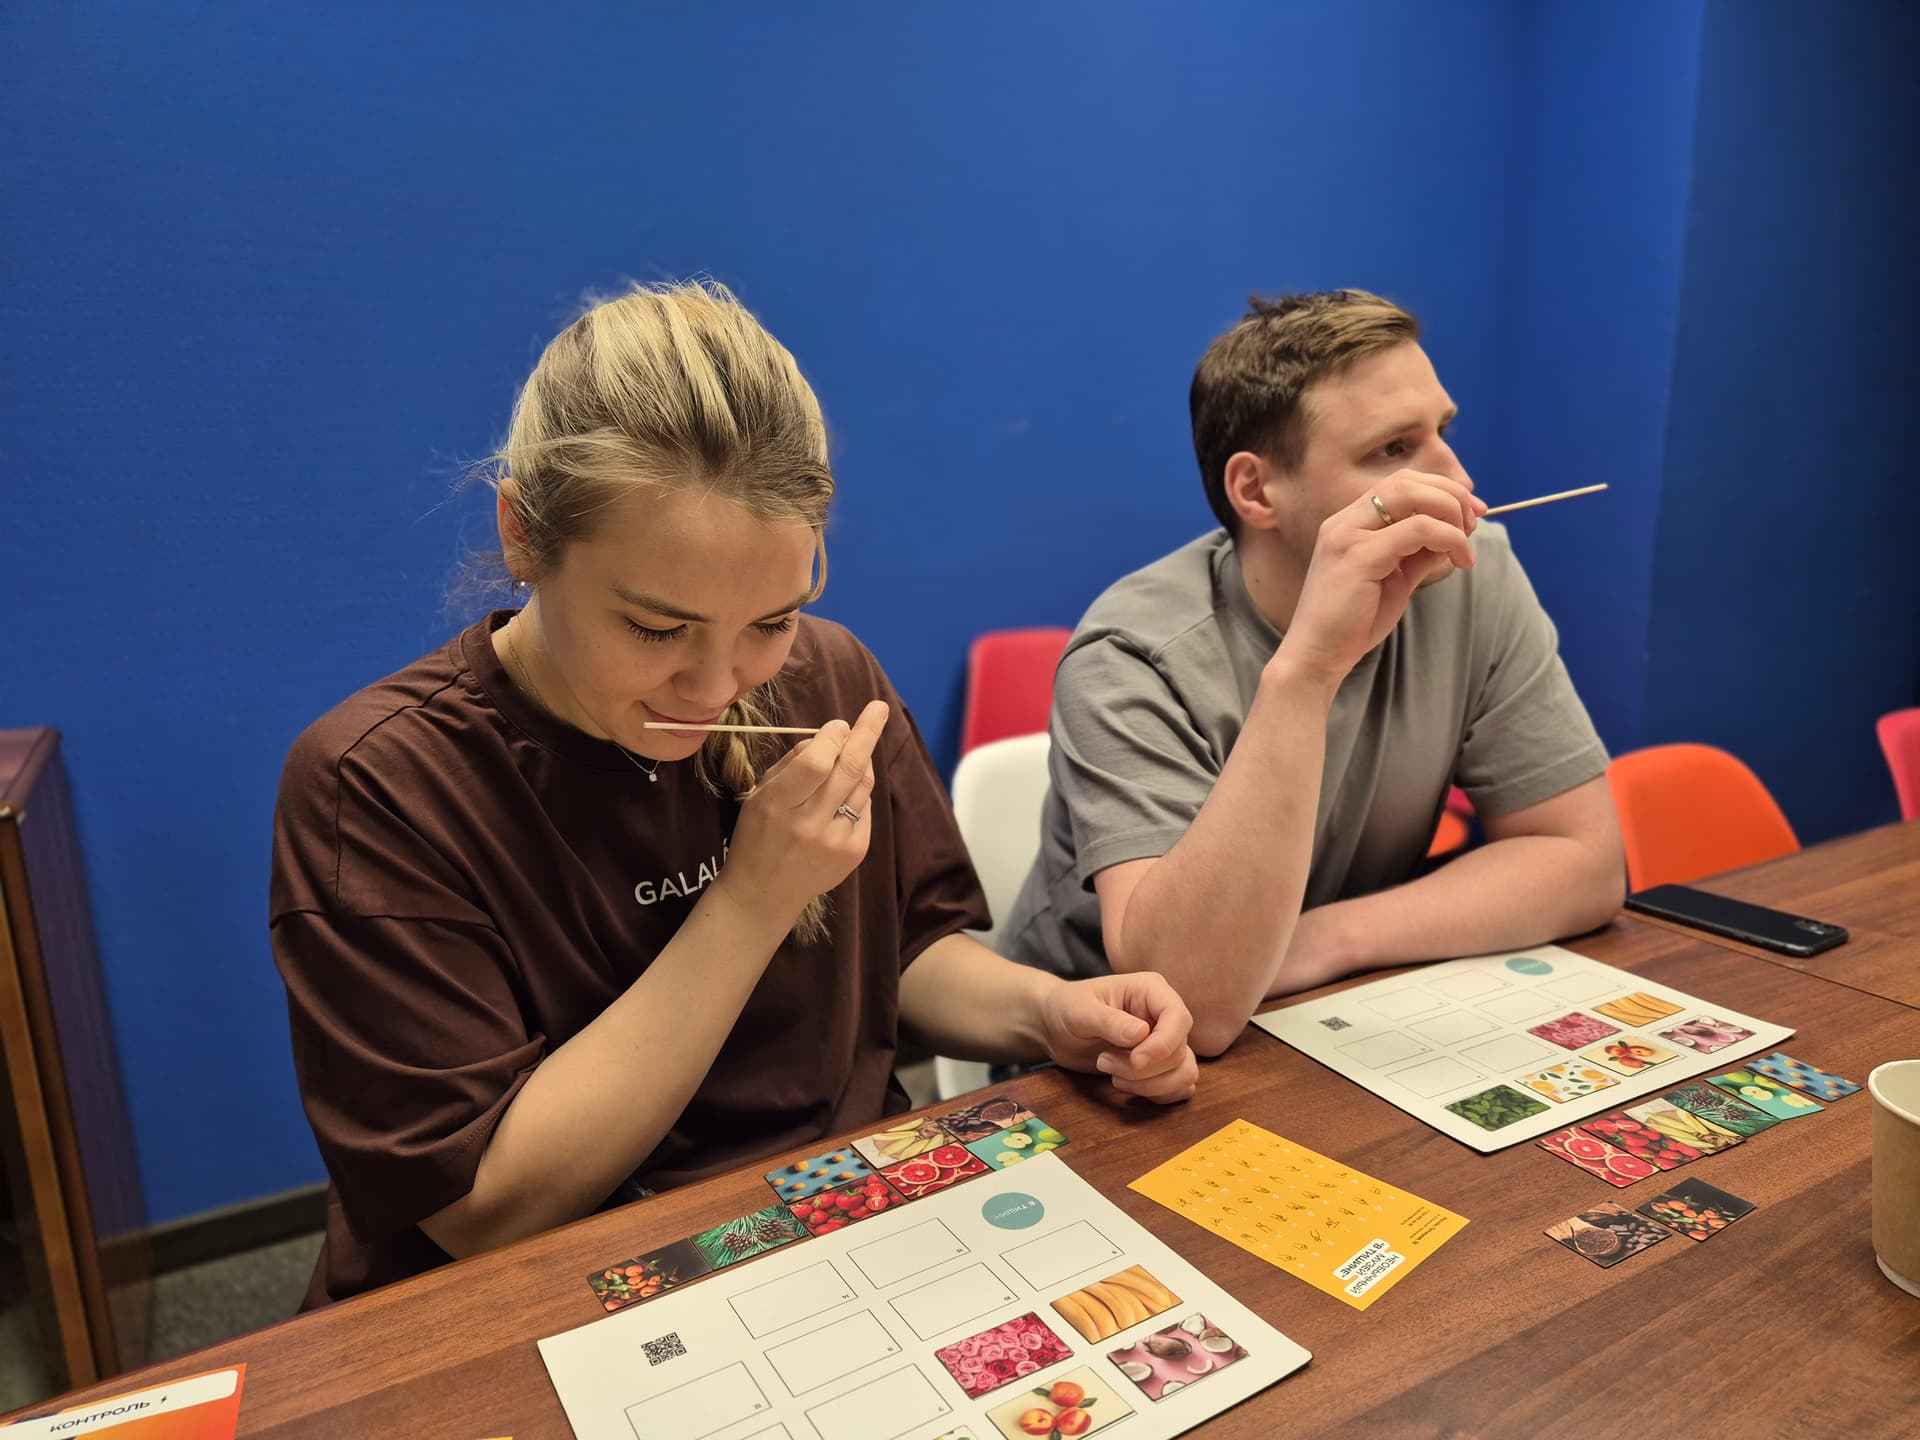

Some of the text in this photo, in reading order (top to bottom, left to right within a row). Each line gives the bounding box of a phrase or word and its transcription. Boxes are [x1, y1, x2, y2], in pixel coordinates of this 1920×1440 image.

[1350, 1254, 1400, 1294] НЕОБЫЧНЫЙ
[1355, 1253, 1386, 1276] МУЗЕЙ
[50, 1401, 151, 1433] КОНТРОЛЬ
